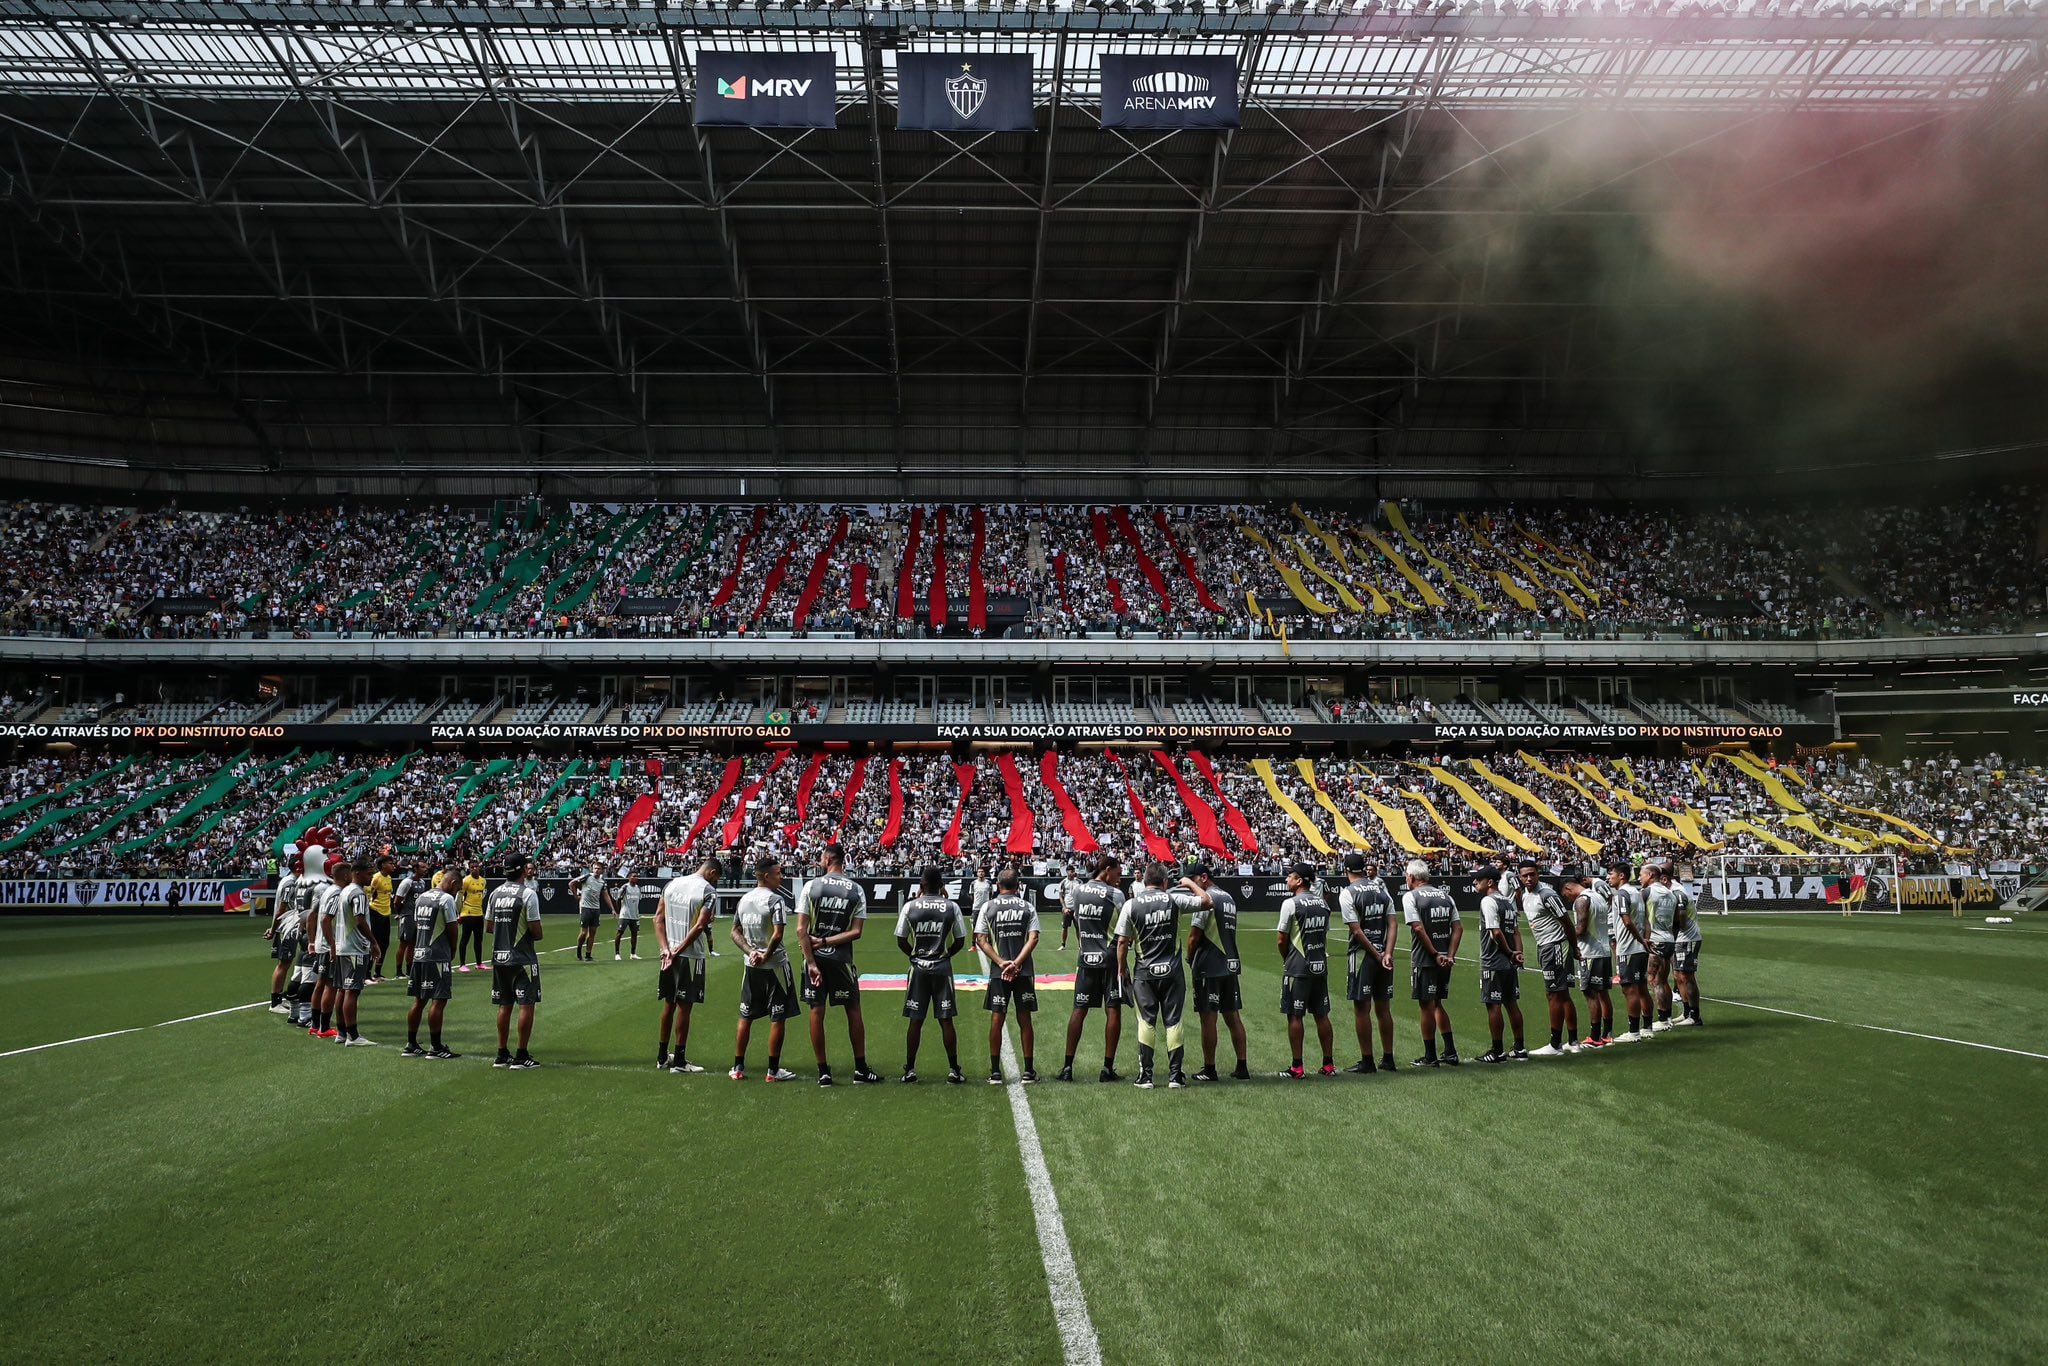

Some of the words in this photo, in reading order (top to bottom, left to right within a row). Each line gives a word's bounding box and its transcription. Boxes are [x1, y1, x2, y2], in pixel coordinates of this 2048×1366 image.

[751, 78, 813, 97] MRV
[951, 82, 981, 90] CAM
[2013, 693, 2048, 707] FAÇA
[51, 724, 108, 737] ATRAVÉS
[112, 726, 131, 737] DO
[135, 726, 155, 737] PIX
[158, 726, 177, 737] DO
[180, 726, 246, 737] INSTITUTO
[249, 726, 285, 737] GALO
[432, 726, 463, 739] FAÇA
[466, 726, 476, 737] A
[479, 726, 503, 737] SUA
[506, 724, 561, 739] DOAÇÃO
[563, 724, 617, 737] ATRAVÉS
[620, 726, 640, 737] DO
[643, 726, 663, 737] PIX
[666, 726, 685, 737] DO
[688, 726, 753, 737] INSTITUTO
[756, 726, 791, 737] GALO
[937, 726, 969, 739] FAÇA
[972, 726, 981, 737] A
[983, 726, 1008, 737] SUA
[1011, 724, 1065, 739] DOAÇÃO
[1067, 724, 1121, 737] ATRAVÉS
[1124, 726, 1143, 737] DO
[1146, 726, 1166, 737] PIX
[1169, 726, 1188, 737] DO
[1191, 726, 1255, 737] INSTITUTO
[1258, 726, 1292, 737] GALO
[1435, 726, 1467, 739] FAÇA
[1469, 726, 1478, 737] A
[1481, 726, 1505, 737] SUA
[1507, 724, 1560, 739] DOAÇÃO
[1562, 724, 1615, 737] ATRAVÉS
[1618, 726, 1637, 737] DO
[1639, 726, 1659, 737] PIX
[1662, 726, 1681, 737] DO
[1683, 726, 1746, 737] INSTITUTO
[1749, 726, 1783, 737] GALO
[828, 879, 854, 890] bmg
[1360, 884, 1381, 893] bmg
[0, 882, 68, 903] MIZADA
[104, 882, 160, 904] FORÇA
[1085, 885, 1107, 898] bmg
[1426, 890, 1445, 900] bmg
[1001, 897, 1026, 908] bmg
[1145, 893, 1170, 904] bmg
[1306, 898, 1325, 908] bmg
[923, 901, 947, 913] bmg
[1087, 954, 1100, 963] BH
[1154, 965, 1167, 973] BH
[1076, 992, 1090, 1002] abc
